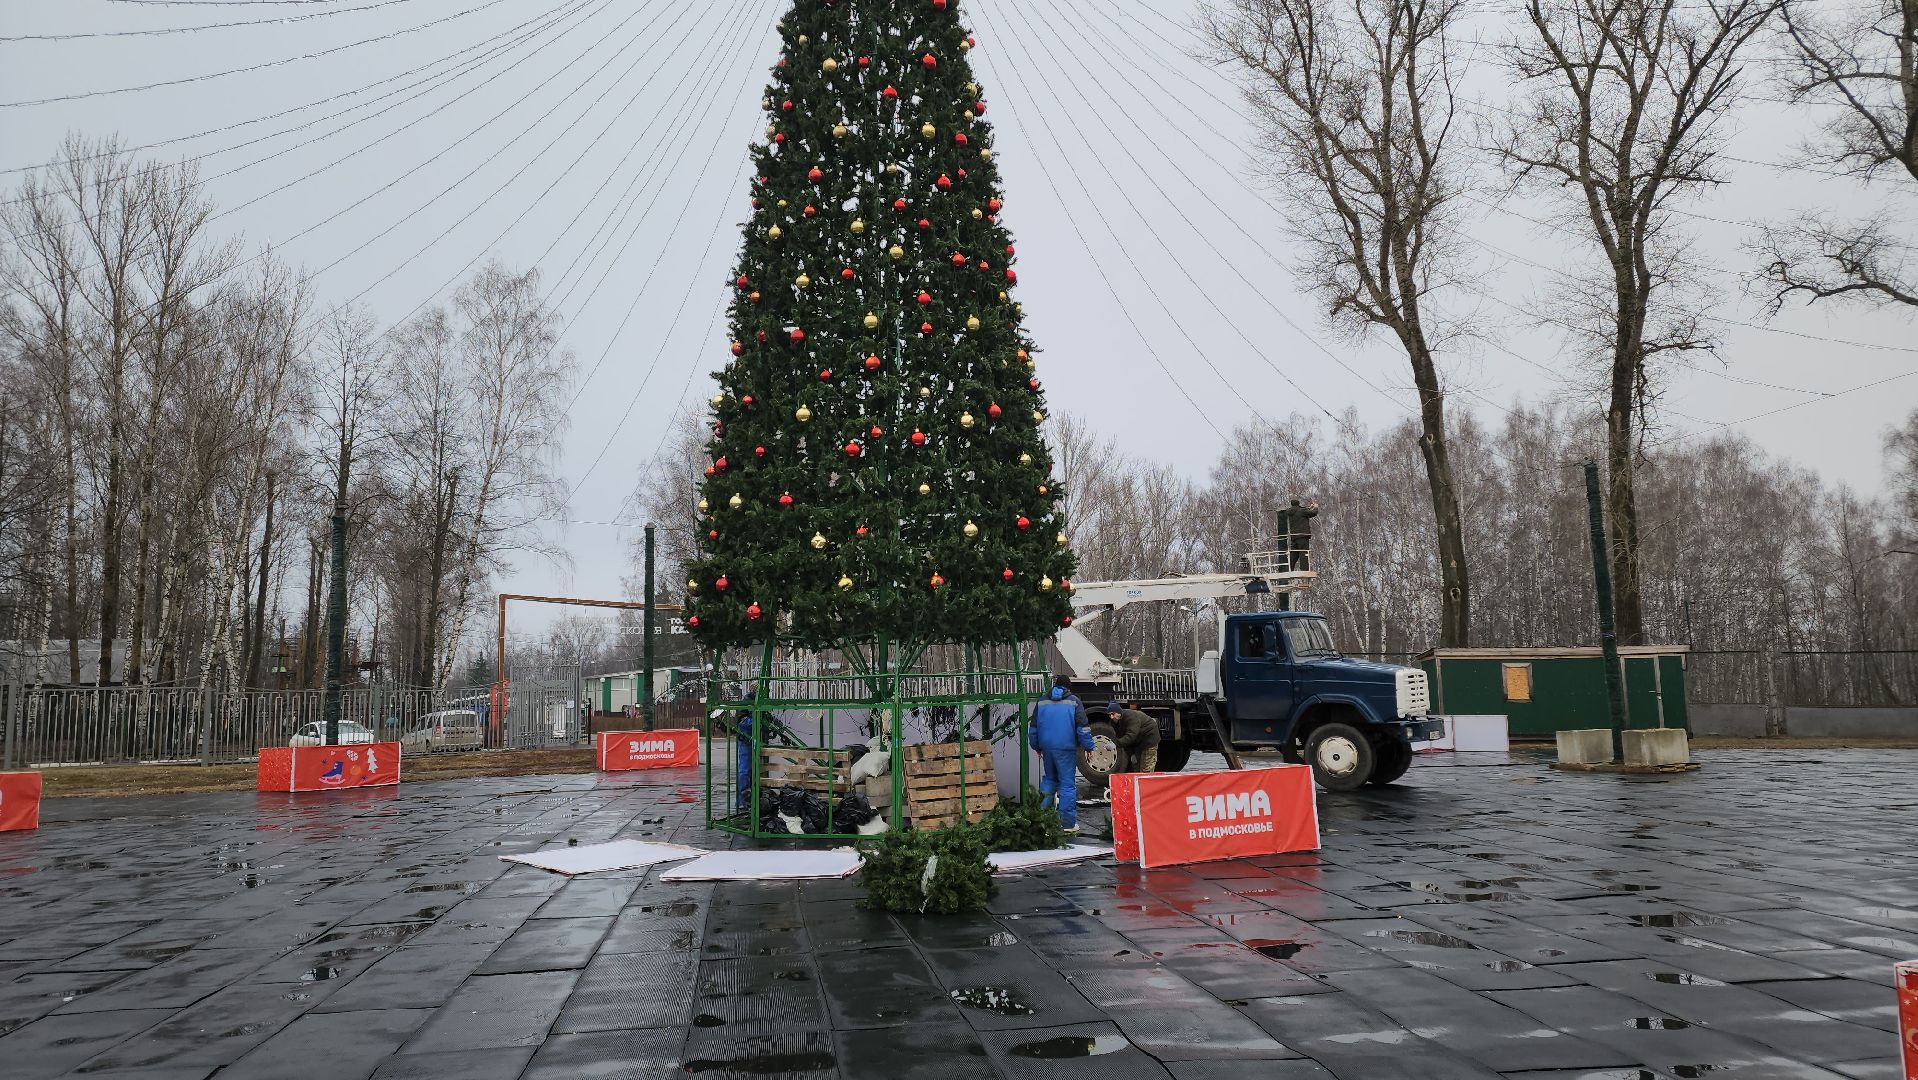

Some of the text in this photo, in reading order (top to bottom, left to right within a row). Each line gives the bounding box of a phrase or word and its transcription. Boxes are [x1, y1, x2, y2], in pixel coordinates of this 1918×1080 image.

[630, 740, 674, 753] ЗИМА
[1186, 789, 1272, 823] ЗИМА
[1189, 821, 1274, 839] В ПОДМОСКОВЬЕ
